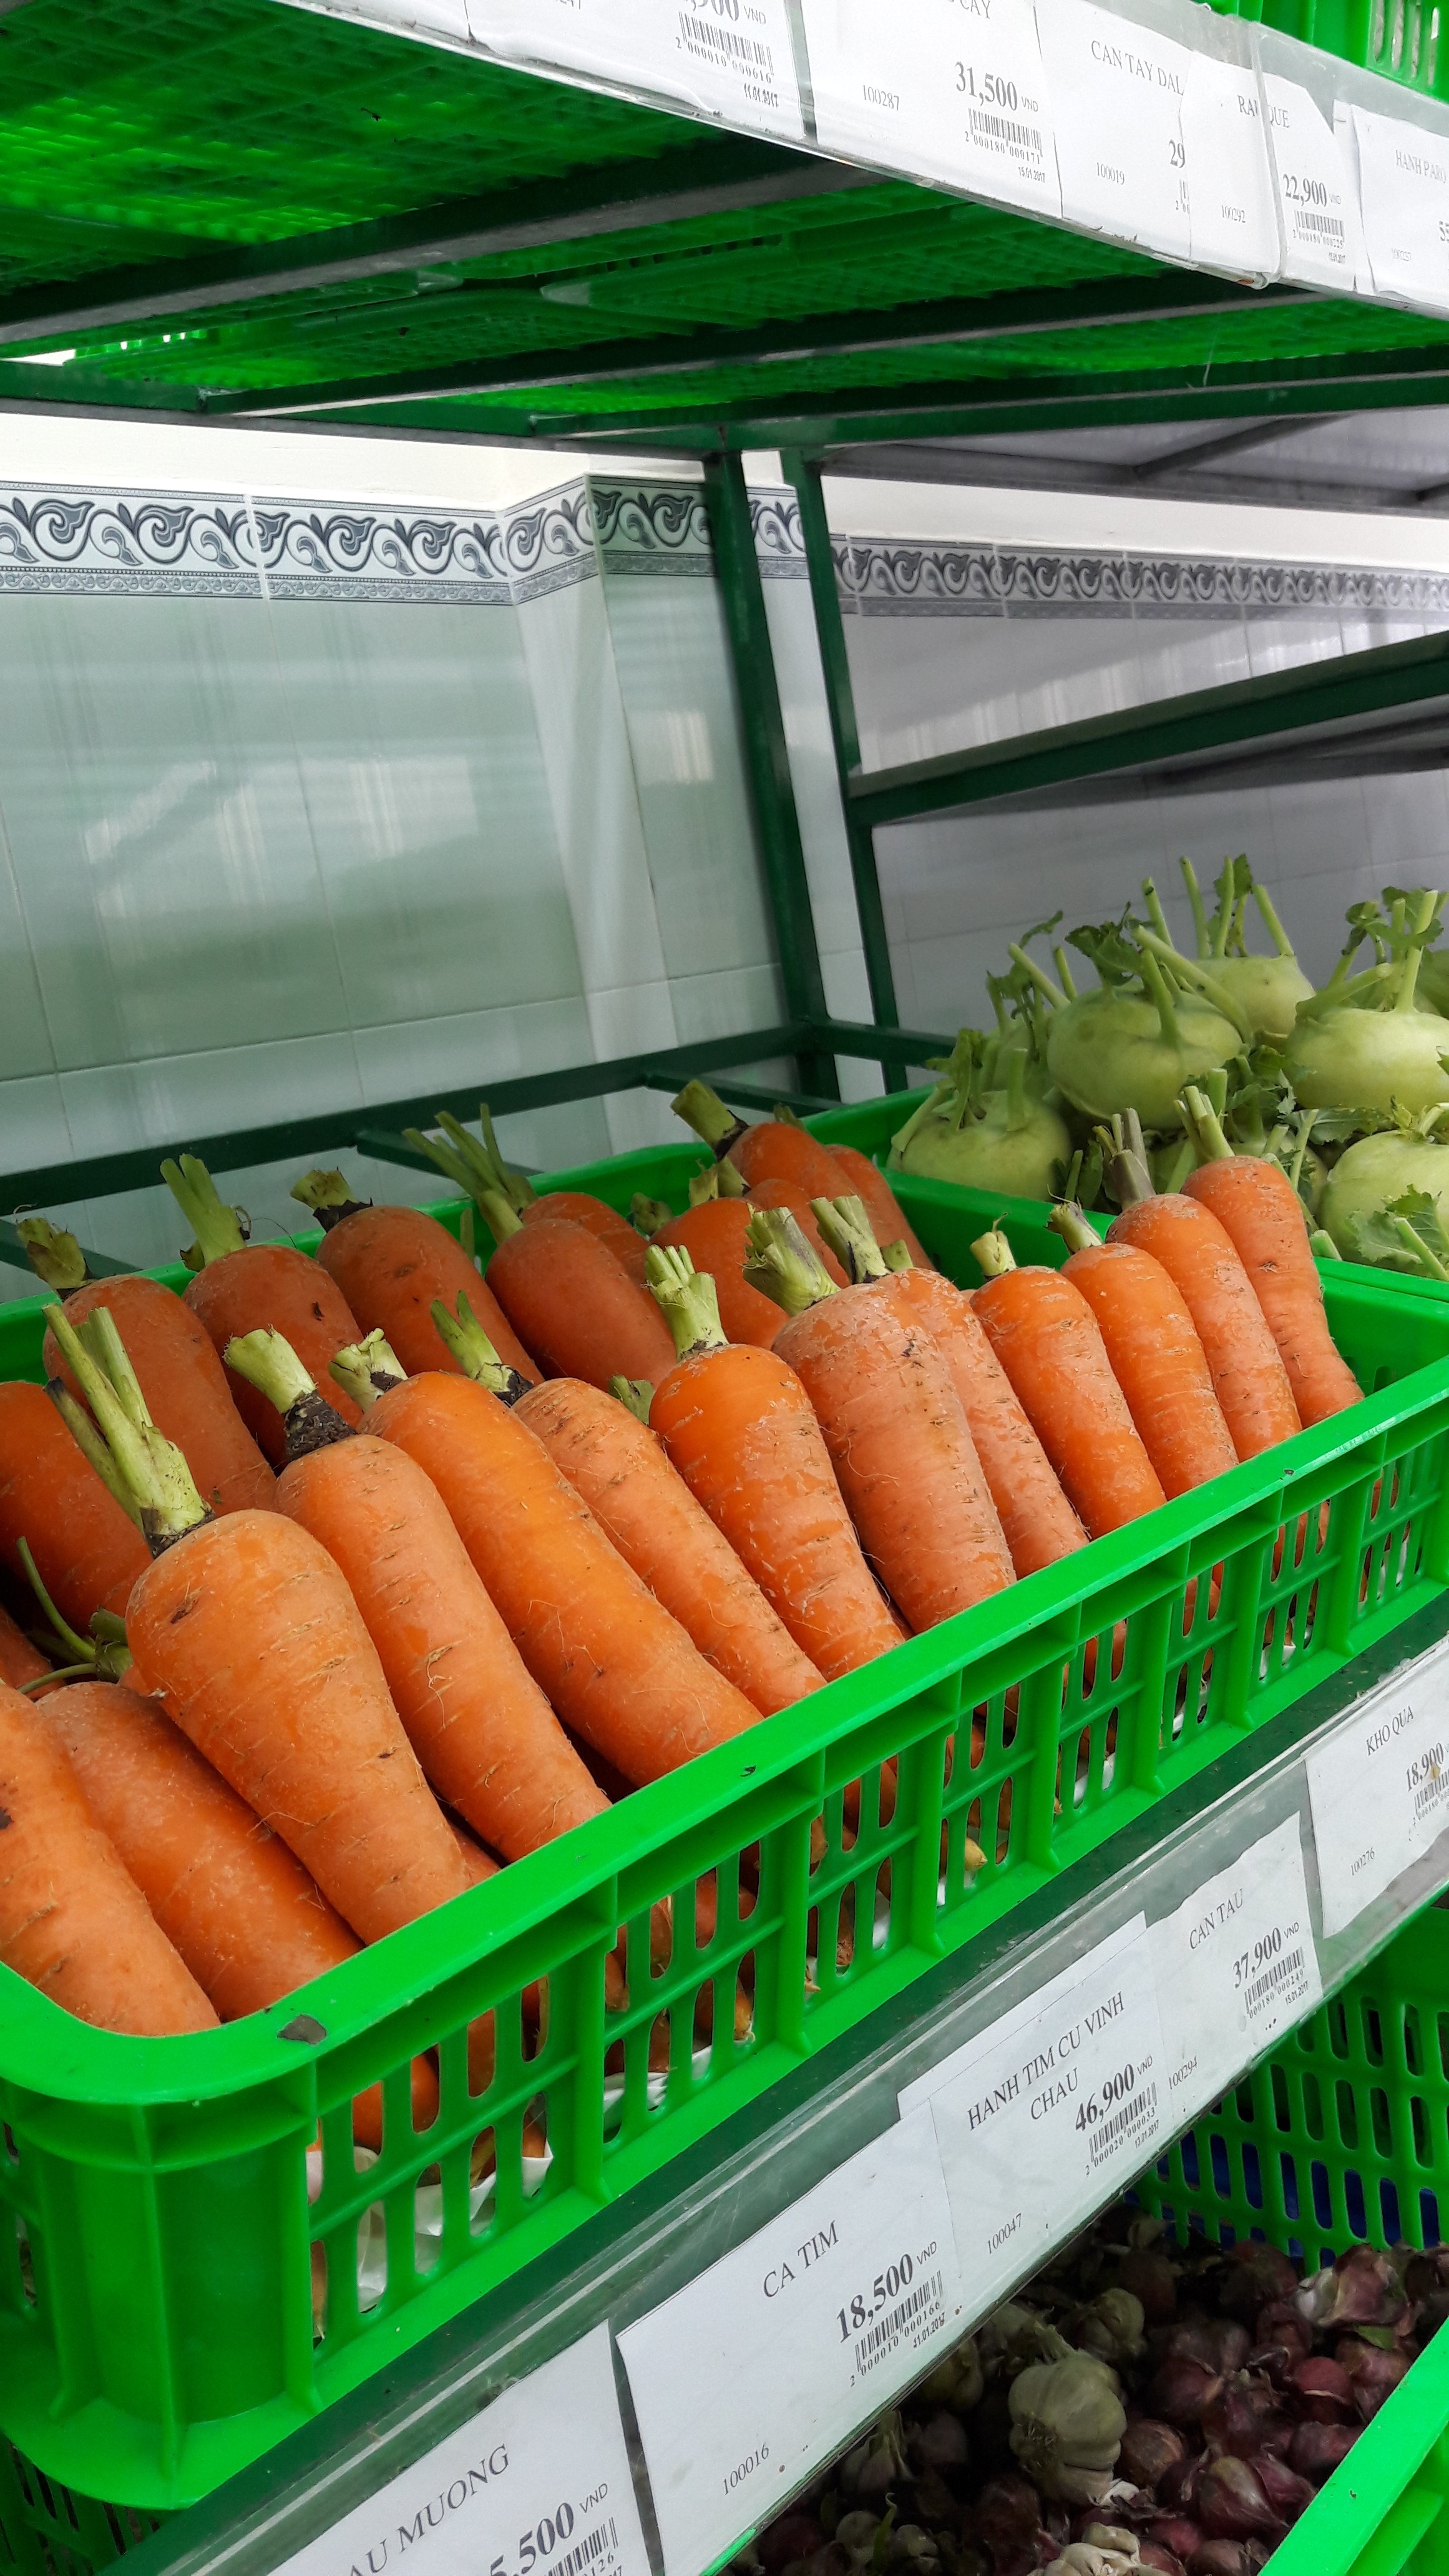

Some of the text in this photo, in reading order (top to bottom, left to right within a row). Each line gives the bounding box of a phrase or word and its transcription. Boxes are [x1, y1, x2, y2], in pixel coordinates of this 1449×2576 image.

[743, 5, 766, 24] VND
[676, 37, 681, 49] 2
[1091, 41, 1123, 69] CAN
[1125, 53, 1153, 81] TAY
[863, 85, 899, 110] 100287
[955, 61, 1038, 112] 31,500 VND
[965, 131, 1040, 164] 2 000180 000171
[1396, 149, 1422, 175] HANH
[1097, 162, 1125, 185] 100019
[1283, 174, 1327, 207] 22,900
[1222, 205, 1247, 223] 100292
[1366, 1705, 1413, 1756] KHO QUA
[1407, 1742, 1444, 1792] 18,900
[1351, 1847, 1375, 1876] 100276
[1189, 1887, 1243, 1949] CAN TAU
[1233, 1922, 1299, 1989] 37,900 VND
[1249, 1991, 1274, 2019] 000180
[967, 1991, 1125, 2131] HANH TIM CU VINH
[1169, 2056, 1198, 2089] 100294
[1030, 2067, 1079, 2120] CHAU
[1076, 2056, 1153, 2131] 46,900 VND
[1094, 2135, 1123, 2167] 000020
[988, 2213, 1022, 2254] 100047
[764, 2220, 839, 2298] CA TIM
[837, 2242, 937, 2343] 18,500 VND
[861, 2336, 899, 2376] 000010
[904, 2301, 940, 2338] 000166
[723, 2442, 769, 2496] 100016
[398, 2443, 509, 2554] MUONG
[579, 2483, 608, 2514] VND
[583, 2552, 614, 2576] 126
